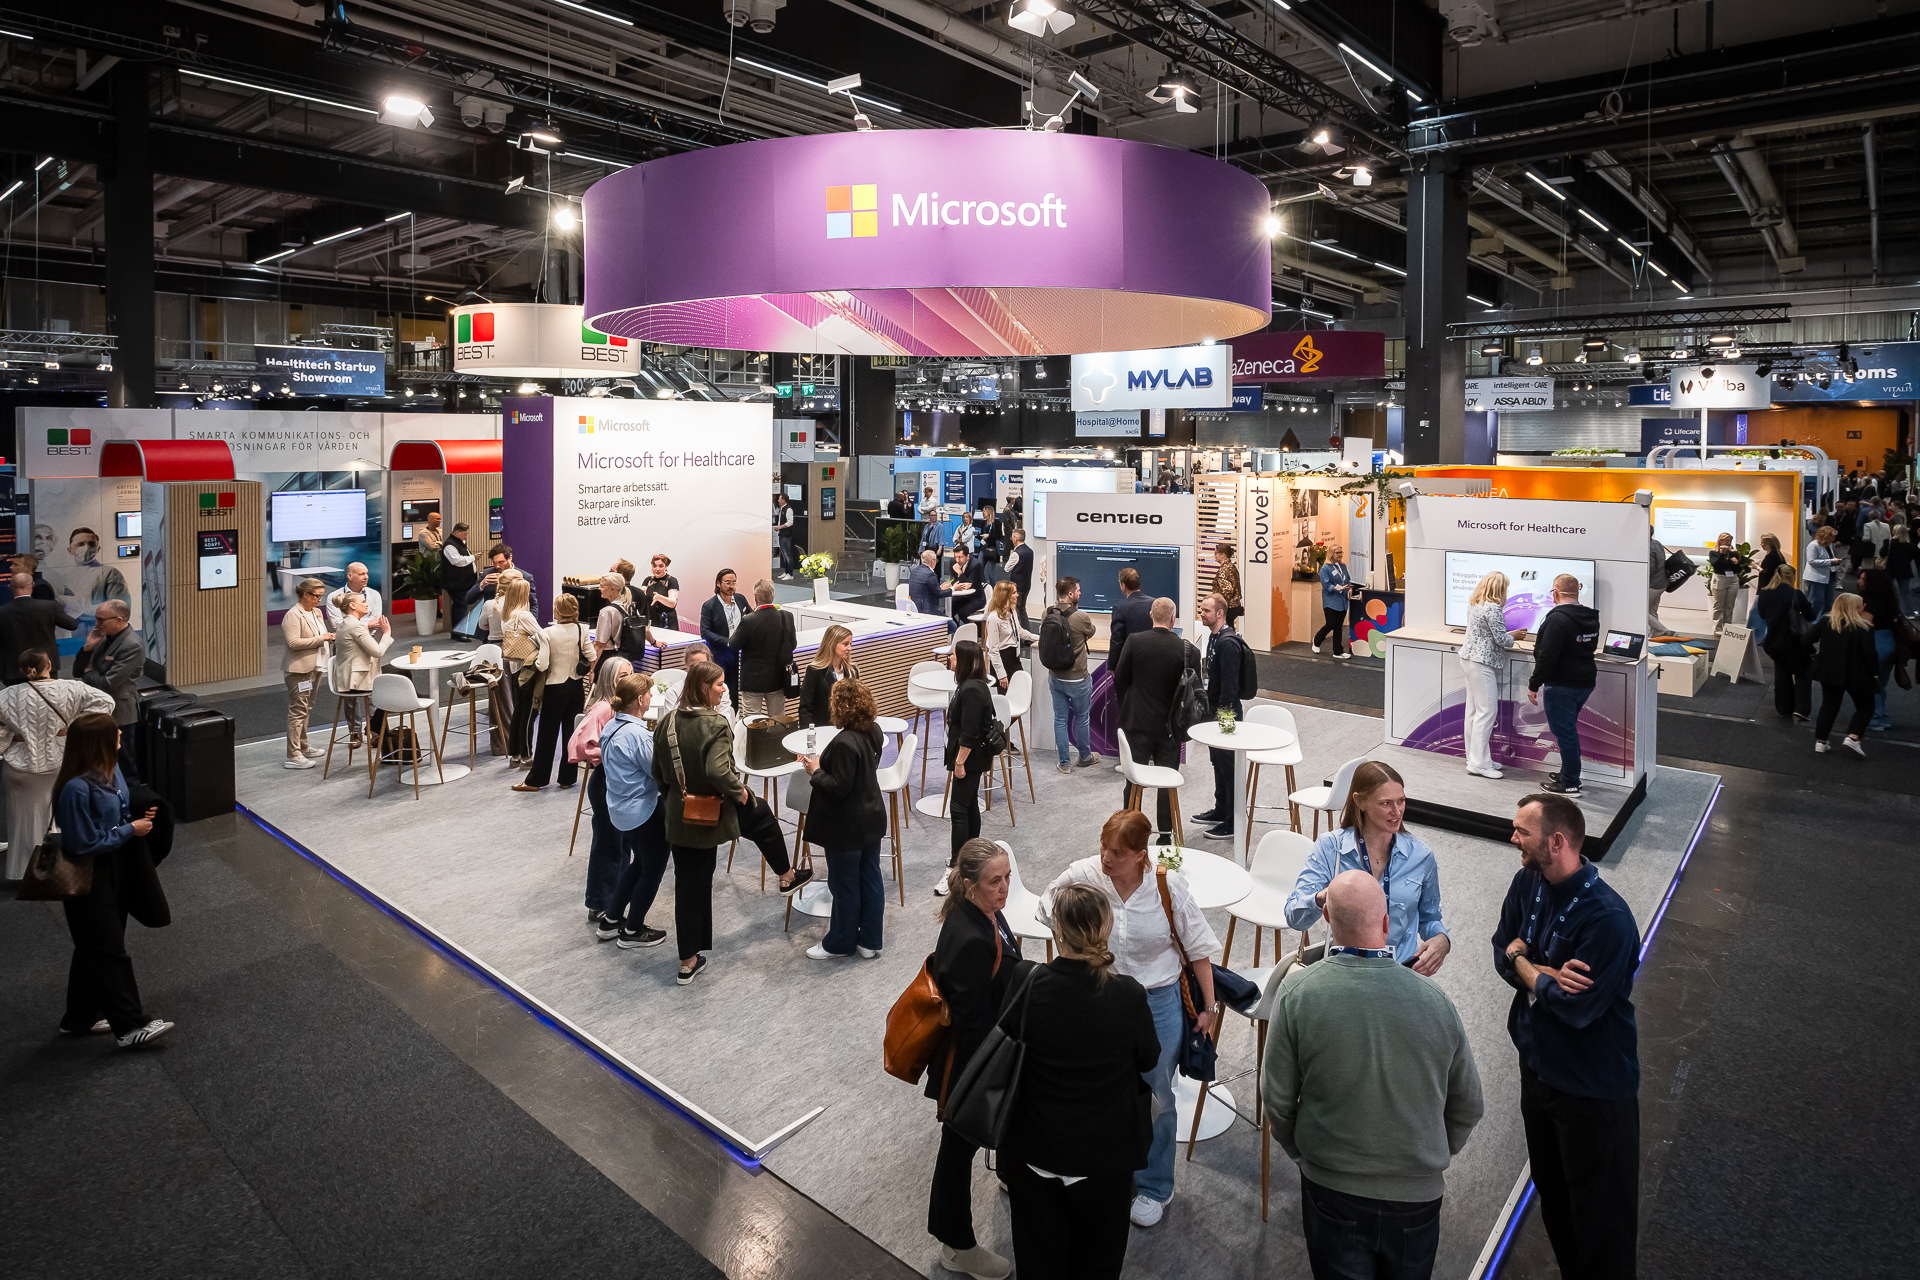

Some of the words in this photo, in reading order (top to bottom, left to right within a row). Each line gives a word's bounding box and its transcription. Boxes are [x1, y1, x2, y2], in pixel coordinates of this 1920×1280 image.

[892, 192, 1067, 228] Microsoft
[458, 345, 494, 360] BEST
[581, 347, 628, 363] BEST
[266, 358, 331, 370] Healthtech
[334, 361, 376, 374] Startup
[1232, 358, 1295, 376] aZeneca
[293, 372, 352, 383] Showroom
[1128, 367, 1213, 391] MYLAB
[1493, 382, 1530, 390] intelligent
[1698, 380, 1745, 391] Viiba
[1882, 382, 1912, 397] VITALIS
[1232, 396, 1252, 405] way
[1494, 398, 1520, 406] ASSA
[1522, 398, 1547, 406] ABLOY
[520, 413, 543, 422] Microsoft
[1076, 417, 1140, 428] Hospital@Home
[598, 420, 650, 432] Microsoft
[189, 431, 235, 440] SMARTA
[242, 431, 345, 440] KOMMUNIKATIONS-
[349, 432, 370, 440] OCH
[47, 447, 91, 456] BEST
[292, 441, 312, 450] FÖR
[318, 440, 358, 450] VÅRDEN
[578, 451, 654, 469] Microsoft
[659, 451, 679, 468] for
[683, 451, 755, 467] Healthcare
[578, 483, 621, 494] Smartare
[623, 481, 669, 493] arbetssätt.
[578, 499, 619, 511] Skarpare
[621, 497, 656, 508] insikter.
[200, 508, 236, 517] BEST
[578, 515, 606, 526] Bättre
[608, 513, 631, 525] vård.
[1249, 486, 1269, 564] bouvet
[1457, 520, 1507, 531] Microsoft
[1509, 521, 1525, 532] for
[1527, 523, 1587, 535] Healthcare
[1452, 571, 1478, 579] Inbyggda
[1724, 628, 1747, 641] bouvet
